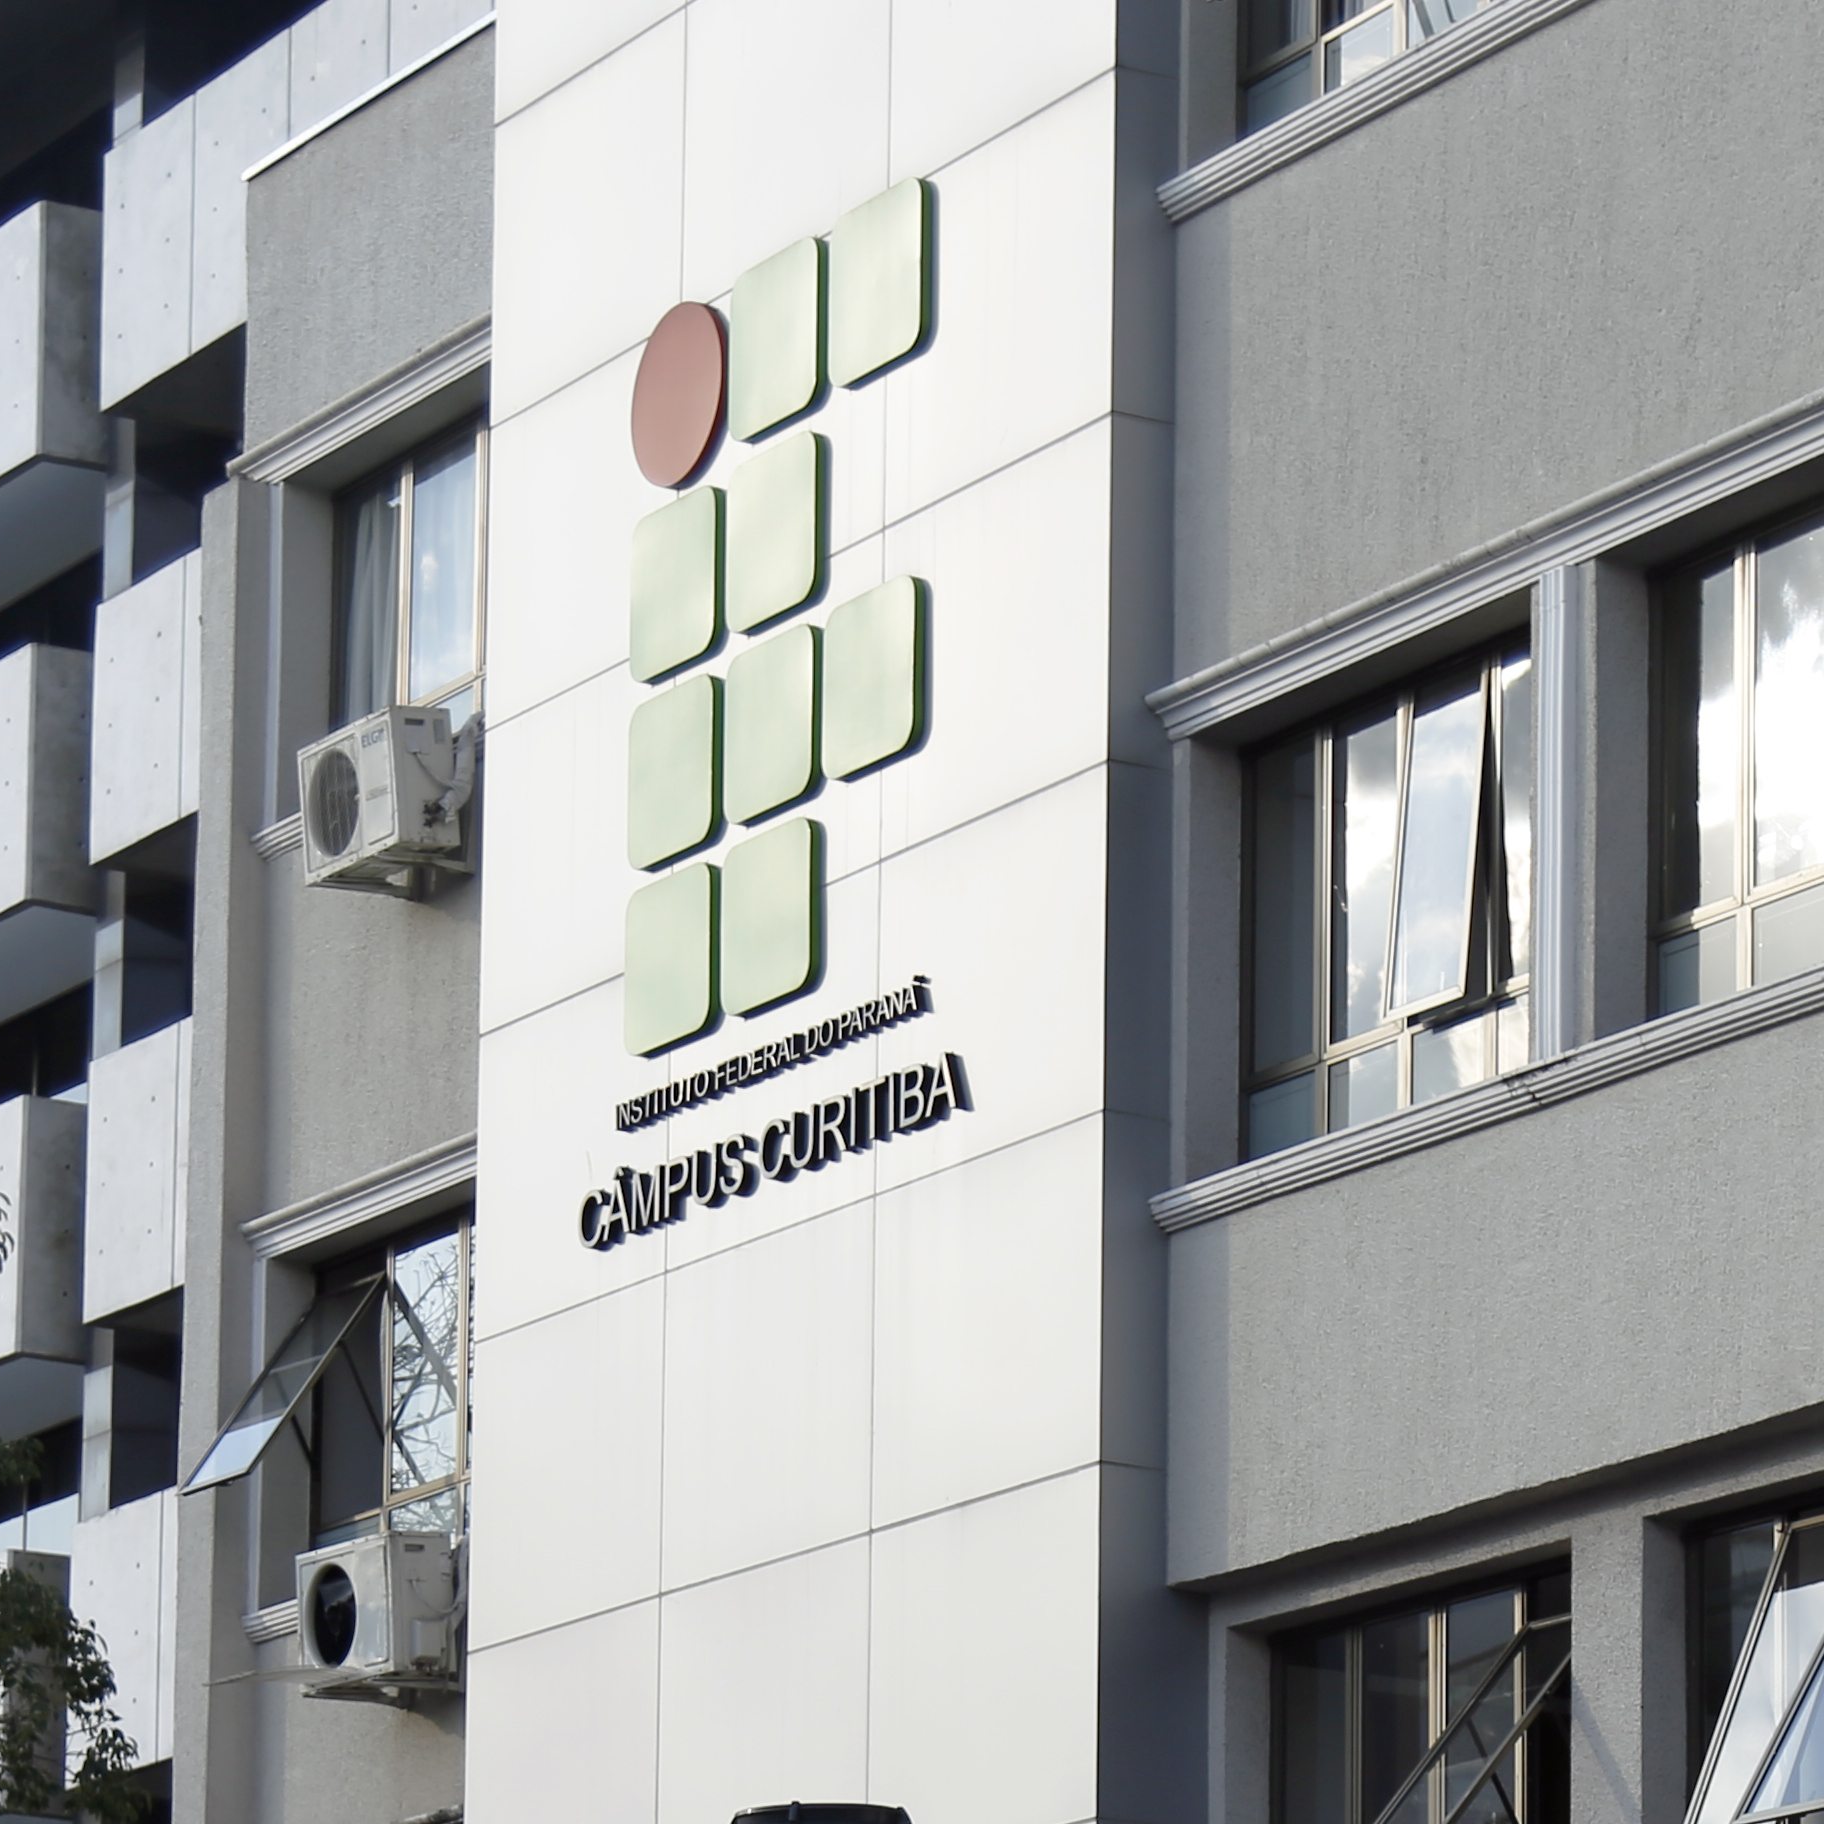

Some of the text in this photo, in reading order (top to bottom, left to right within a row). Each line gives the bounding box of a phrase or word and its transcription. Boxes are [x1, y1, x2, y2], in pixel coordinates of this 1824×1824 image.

[616, 975, 934, 1131] INSTITUTO FEDERAL DO PARANÁ
[578, 1052, 974, 1250] CÂMPUS CURITIBA
